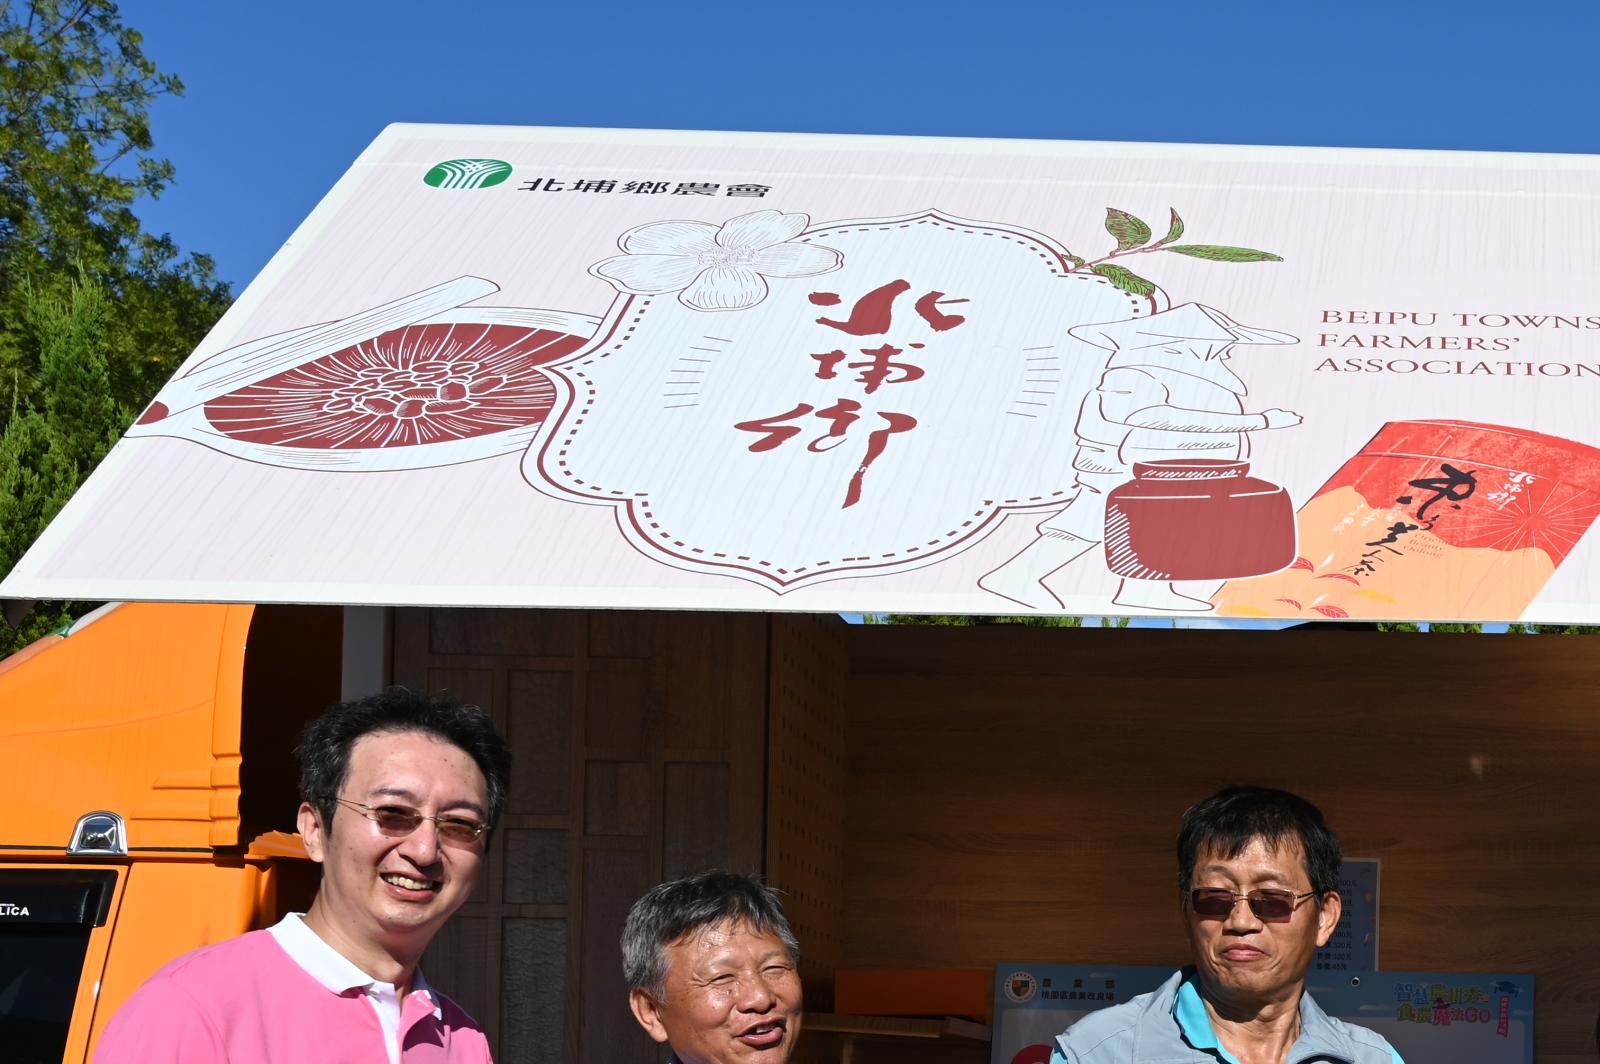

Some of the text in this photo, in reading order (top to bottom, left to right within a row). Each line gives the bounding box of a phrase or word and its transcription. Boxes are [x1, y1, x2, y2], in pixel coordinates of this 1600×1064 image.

[517, 178, 773, 198] 北埔鄉農會
[1320, 310, 1438, 326] BEIPU
